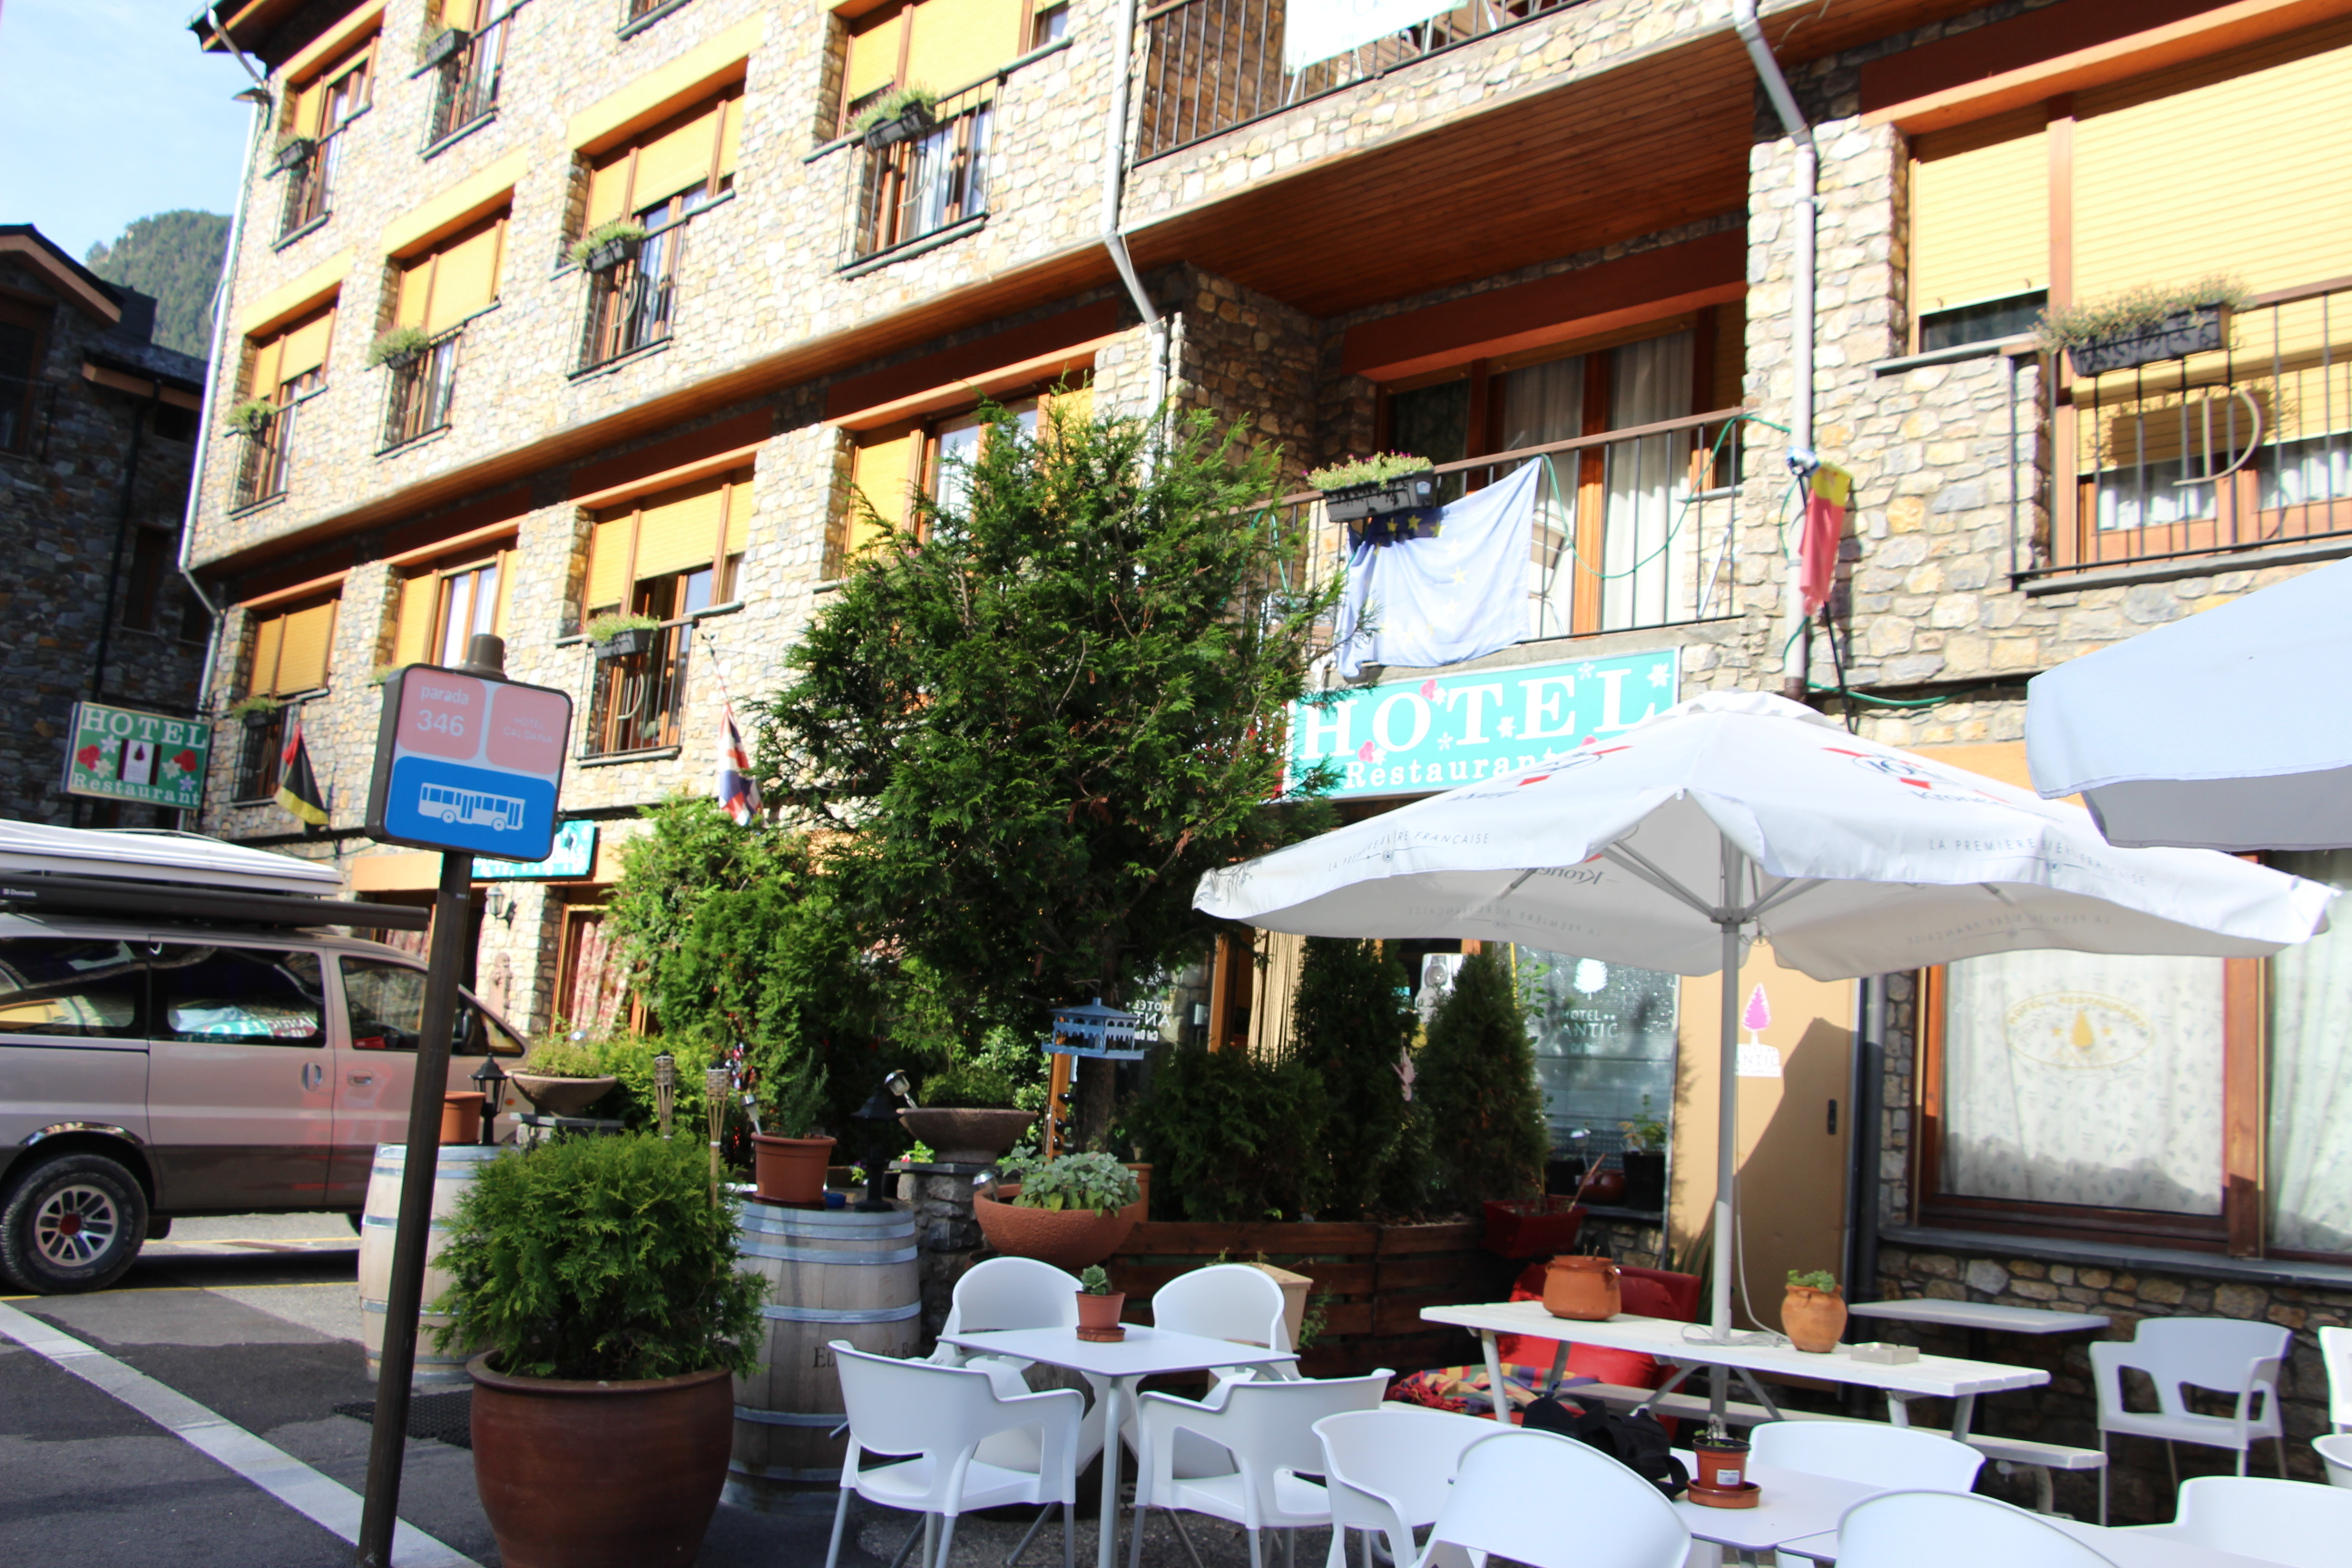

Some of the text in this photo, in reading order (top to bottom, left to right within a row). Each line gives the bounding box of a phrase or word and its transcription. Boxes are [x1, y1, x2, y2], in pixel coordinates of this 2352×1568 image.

[420, 685, 470, 705] parada
[416, 709, 466, 737] 346
[1299, 668, 1656, 760] HOTEL
[82, 707, 207, 750] HOTEL
[514, 717, 544, 730] HOTEL
[71, 771, 201, 805] Restaurant
[1414, 830, 1490, 846] FRANÇAISE
[1930, 838, 1946, 850] LA
[1956, 837, 2036, 852] PREMIÈRE
[1562, 1009, 1602, 1022] HOTEL
[1561, 1022, 1619, 1038] ANTIC
